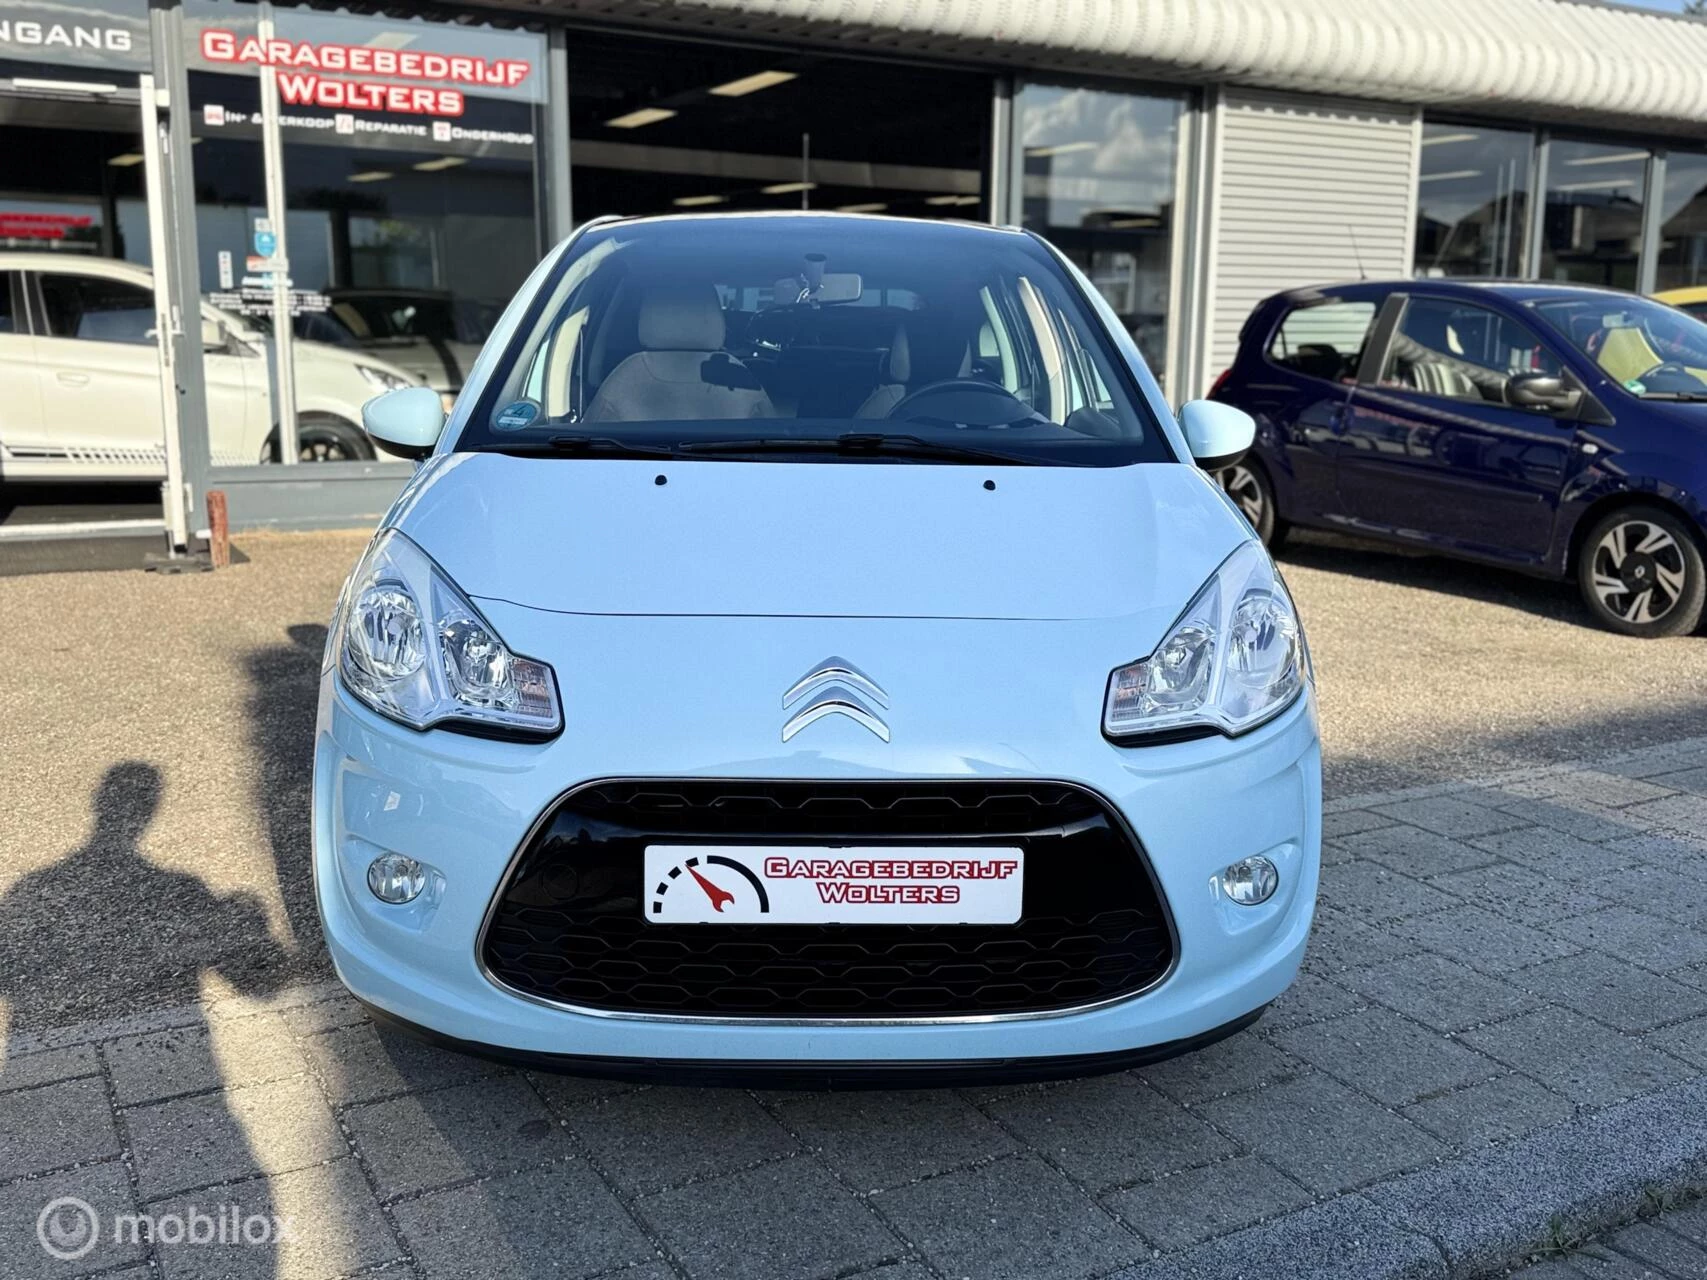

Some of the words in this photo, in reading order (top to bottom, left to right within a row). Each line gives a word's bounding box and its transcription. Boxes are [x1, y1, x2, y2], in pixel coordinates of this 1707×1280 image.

[277, 72, 463, 115] WOLTERS
[764, 856, 1018, 880] GARAGEBEDRIJF
[816, 882, 960, 904] WOLTERS
